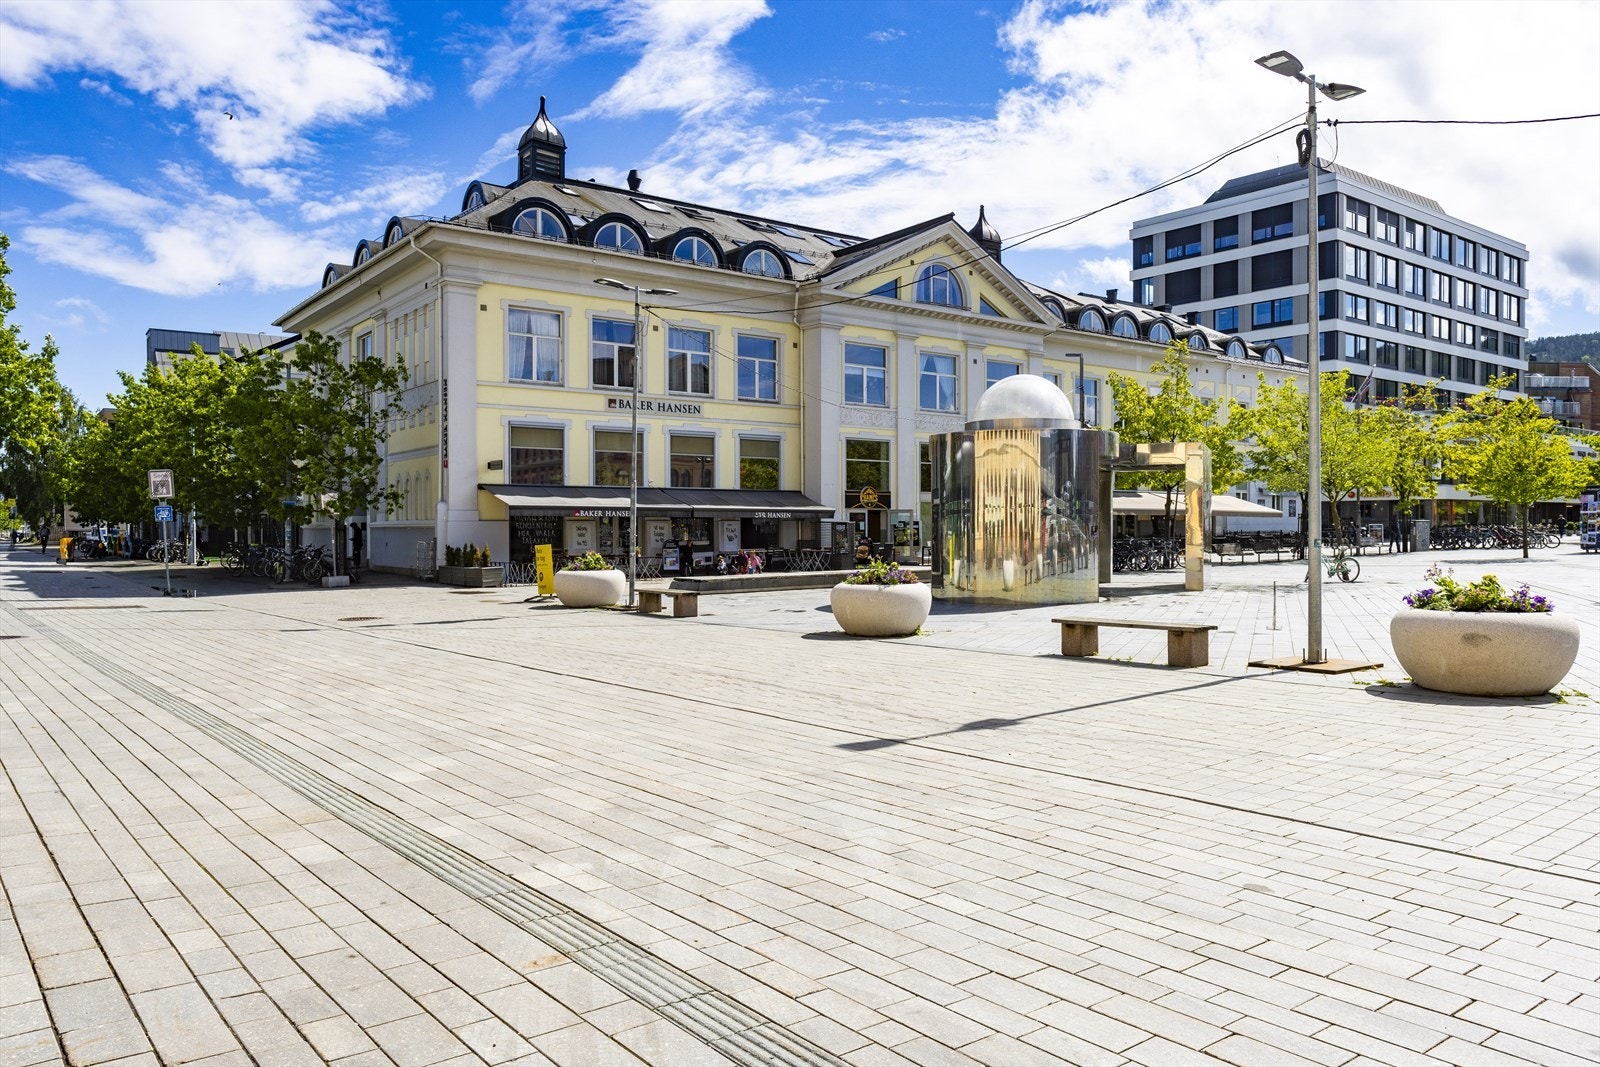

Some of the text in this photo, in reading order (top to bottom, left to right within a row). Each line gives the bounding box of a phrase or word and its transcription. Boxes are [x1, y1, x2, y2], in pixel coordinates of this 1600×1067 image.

[618, 399, 701, 414] BAER HANSEN
[580, 509, 603, 517] BAKER
